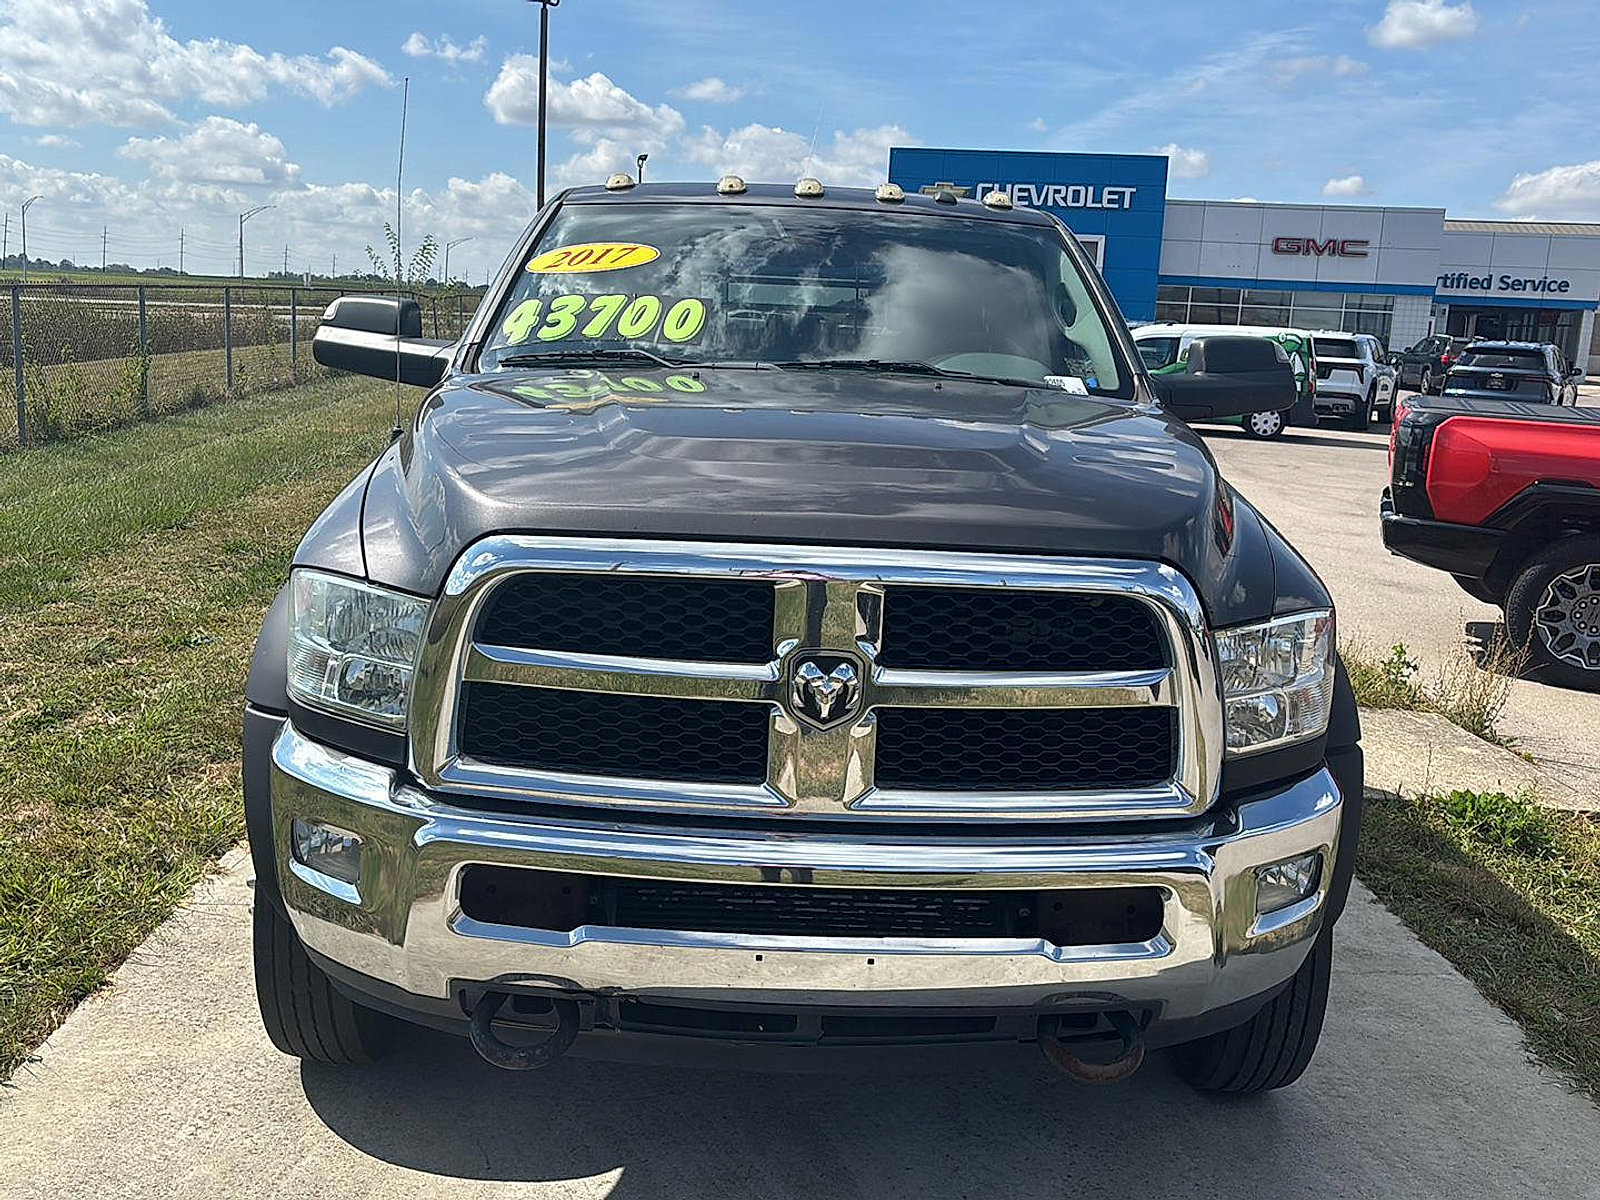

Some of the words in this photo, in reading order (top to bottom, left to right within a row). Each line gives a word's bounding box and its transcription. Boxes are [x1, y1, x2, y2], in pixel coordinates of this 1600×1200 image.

[976, 183, 1136, 208] CHEVROLET
[542, 246, 639, 270] 2017
[1272, 238, 1369, 258] GMC
[1498, 274, 1570, 292] Service
[502, 294, 706, 346] 43700
